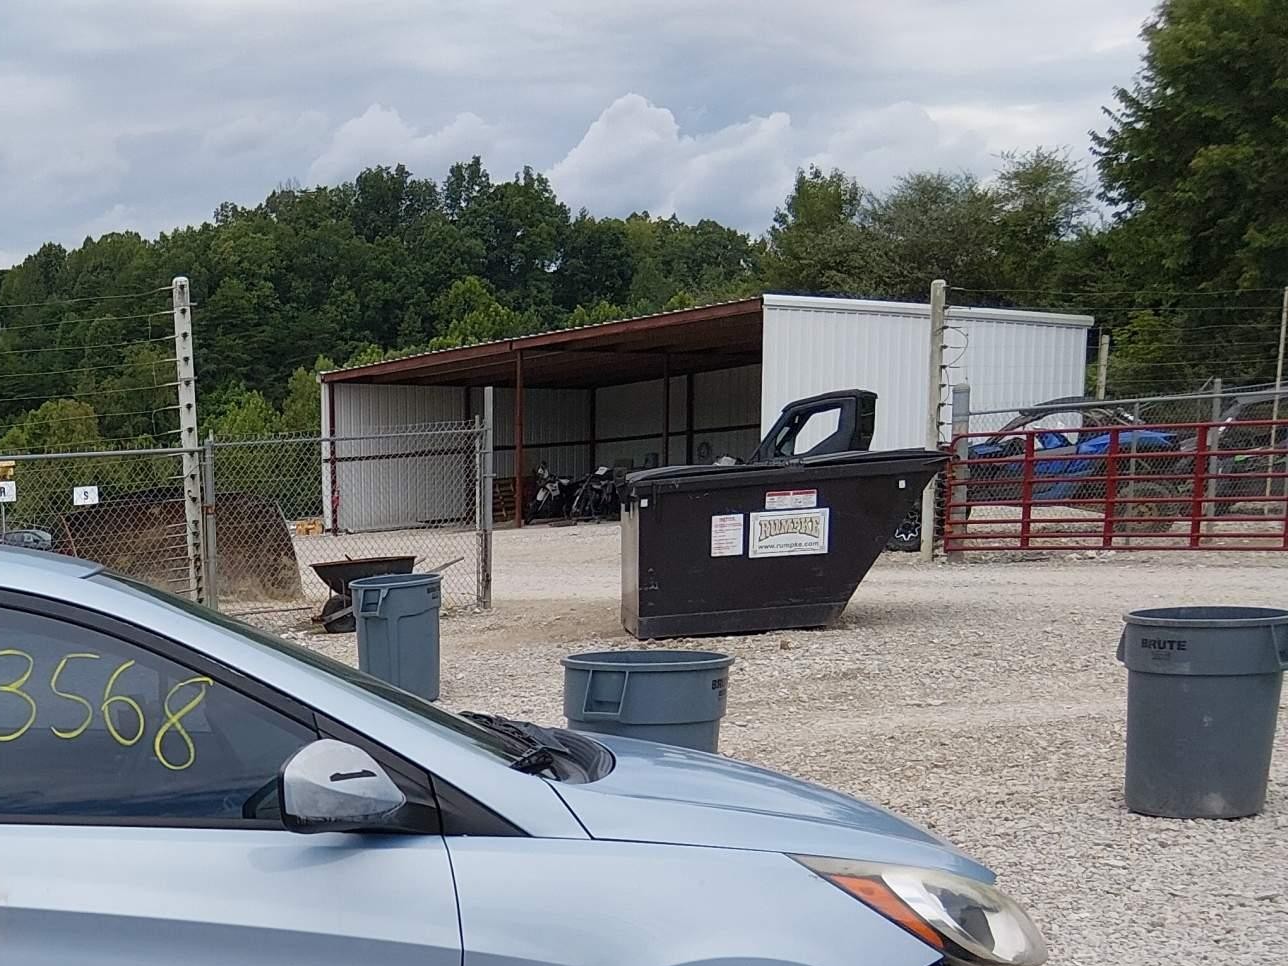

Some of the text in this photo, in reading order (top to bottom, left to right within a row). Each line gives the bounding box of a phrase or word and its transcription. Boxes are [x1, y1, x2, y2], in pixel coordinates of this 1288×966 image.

[0, 486, 6, 497] R
[83, 490, 89, 501] S
[759, 516, 821, 542] RUMPKE
[758, 541, 819, 550] www.rumpke.com
[1141, 638, 1187, 651] BRUTE
